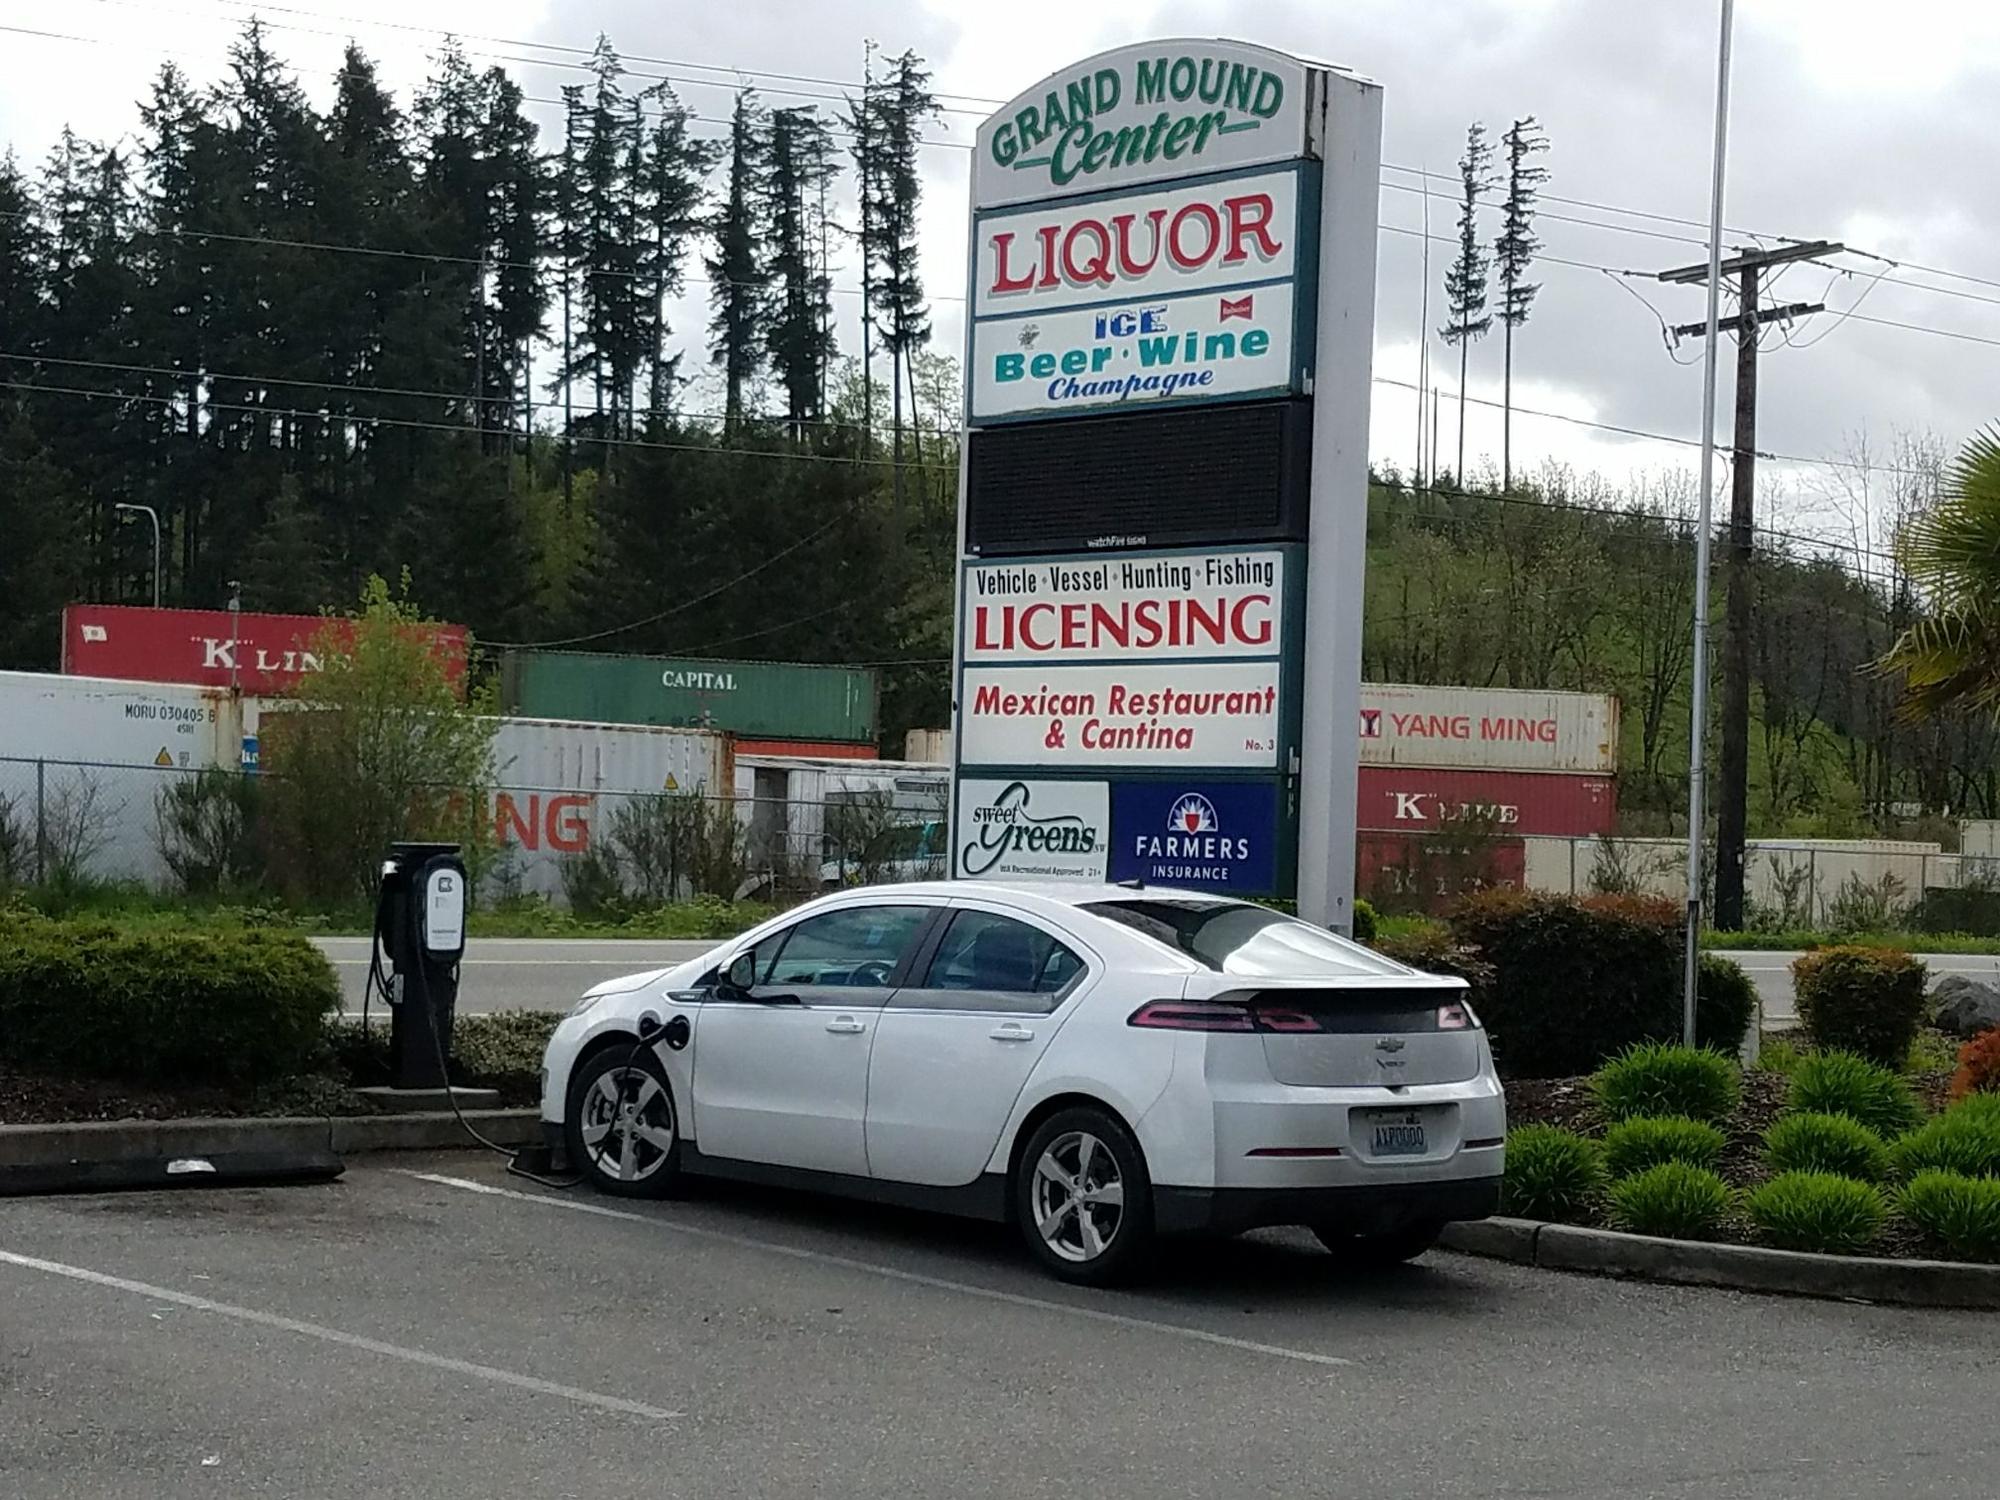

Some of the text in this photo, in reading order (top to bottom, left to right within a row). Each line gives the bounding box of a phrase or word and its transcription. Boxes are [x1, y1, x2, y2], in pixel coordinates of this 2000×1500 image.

[991, 56, 1284, 167] GRAND MOUND
[1049, 110, 1228, 186] Center
[989, 192, 1283, 295] LIQUOR
[1094, 304, 1168, 340] ICE
[995, 328, 1271, 383] Beer Wine
[1047, 369, 1215, 401] Champagne
[976, 557, 1275, 596] Vehicle Vessel Hunting Fishing
[973, 593, 1273, 652] LICENSING
[662, 670, 738, 690] CAPITAL
[159, 705, 204, 723] 030405
[973, 685, 1276, 717] Mexican Restaurant
[1044, 719, 1195, 750] & Cantina
[1391, 713, 1471, 740] YANG
[1480, 717, 1557, 743] MING
[1245, 738, 1276, 751] No. 3
[973, 803, 1019, 823] sweet
[1136, 836, 1249, 860] FARMERS
[1152, 865, 1229, 881] INSURANCE
